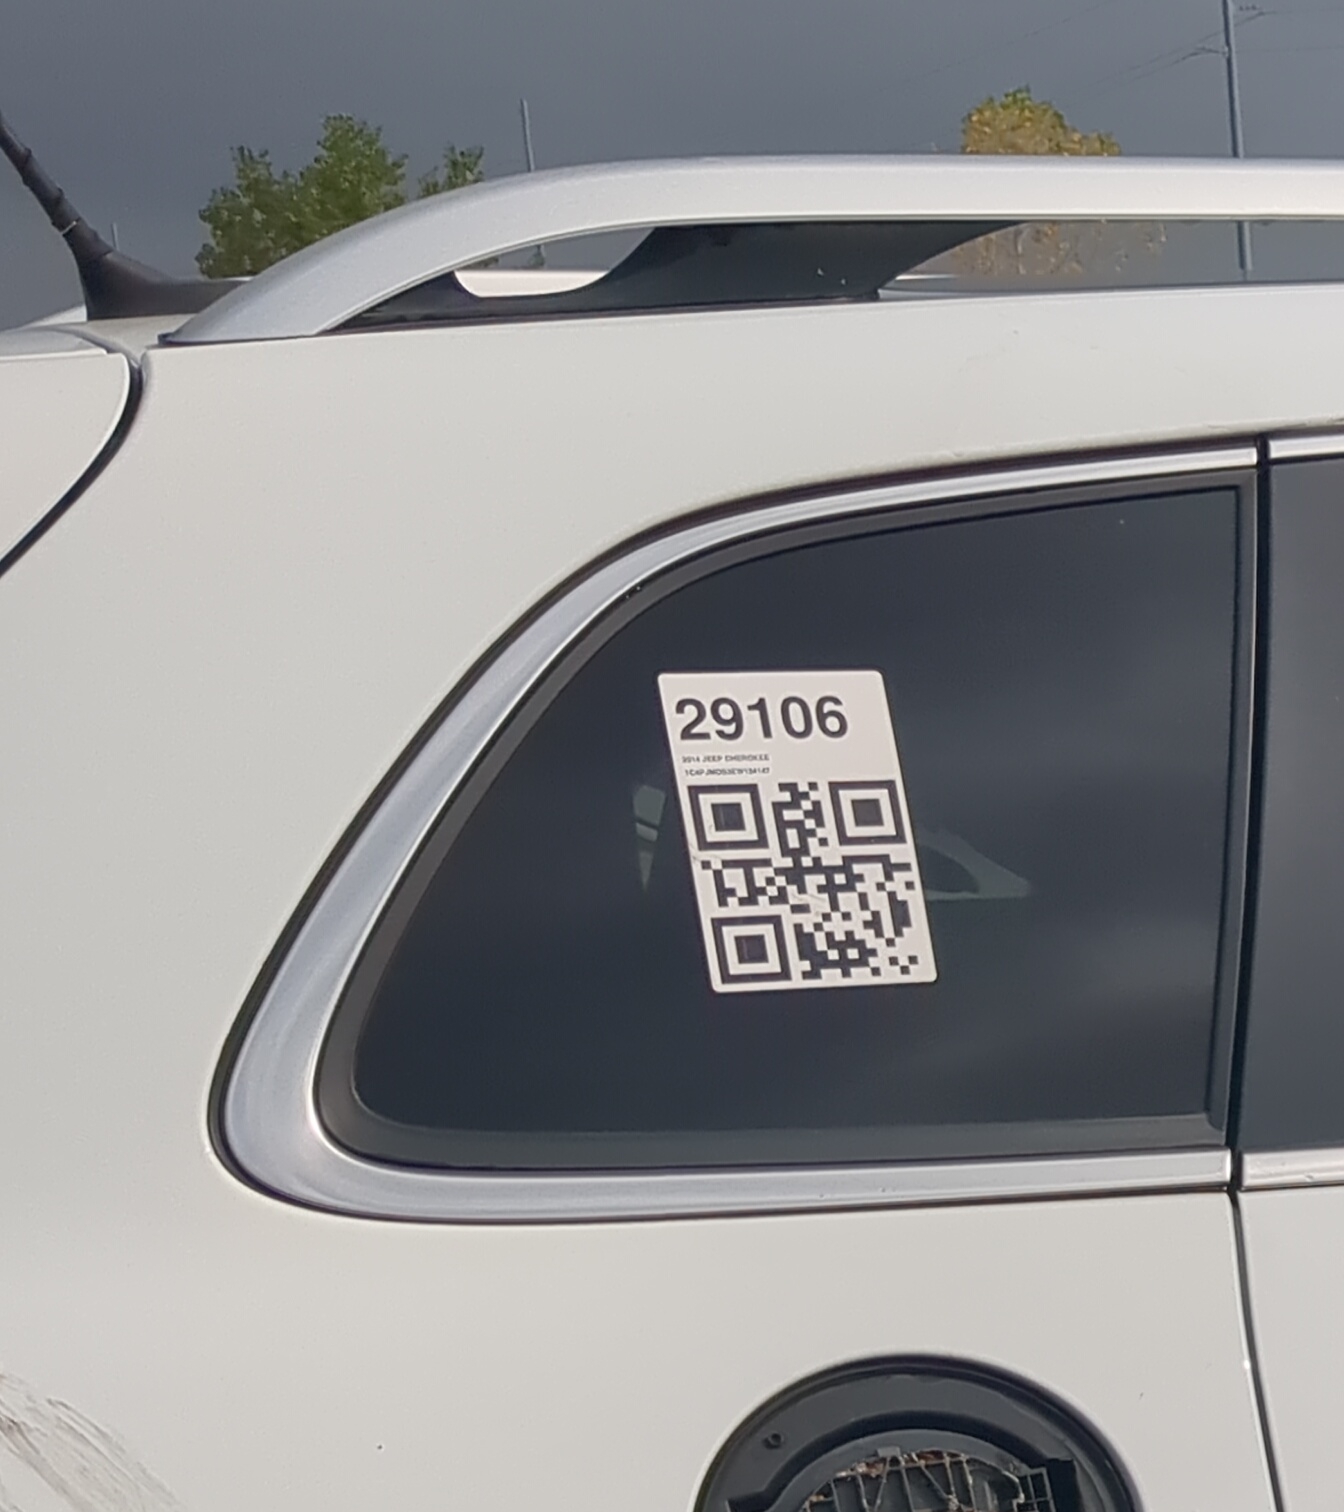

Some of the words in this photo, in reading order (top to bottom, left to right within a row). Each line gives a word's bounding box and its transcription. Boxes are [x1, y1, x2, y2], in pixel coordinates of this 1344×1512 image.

[674, 695, 849, 741] 29106
[681, 755, 701, 763] 2014
[702, 754, 723, 763] JEEP
[724, 753, 770, 762] CHEROKEE
